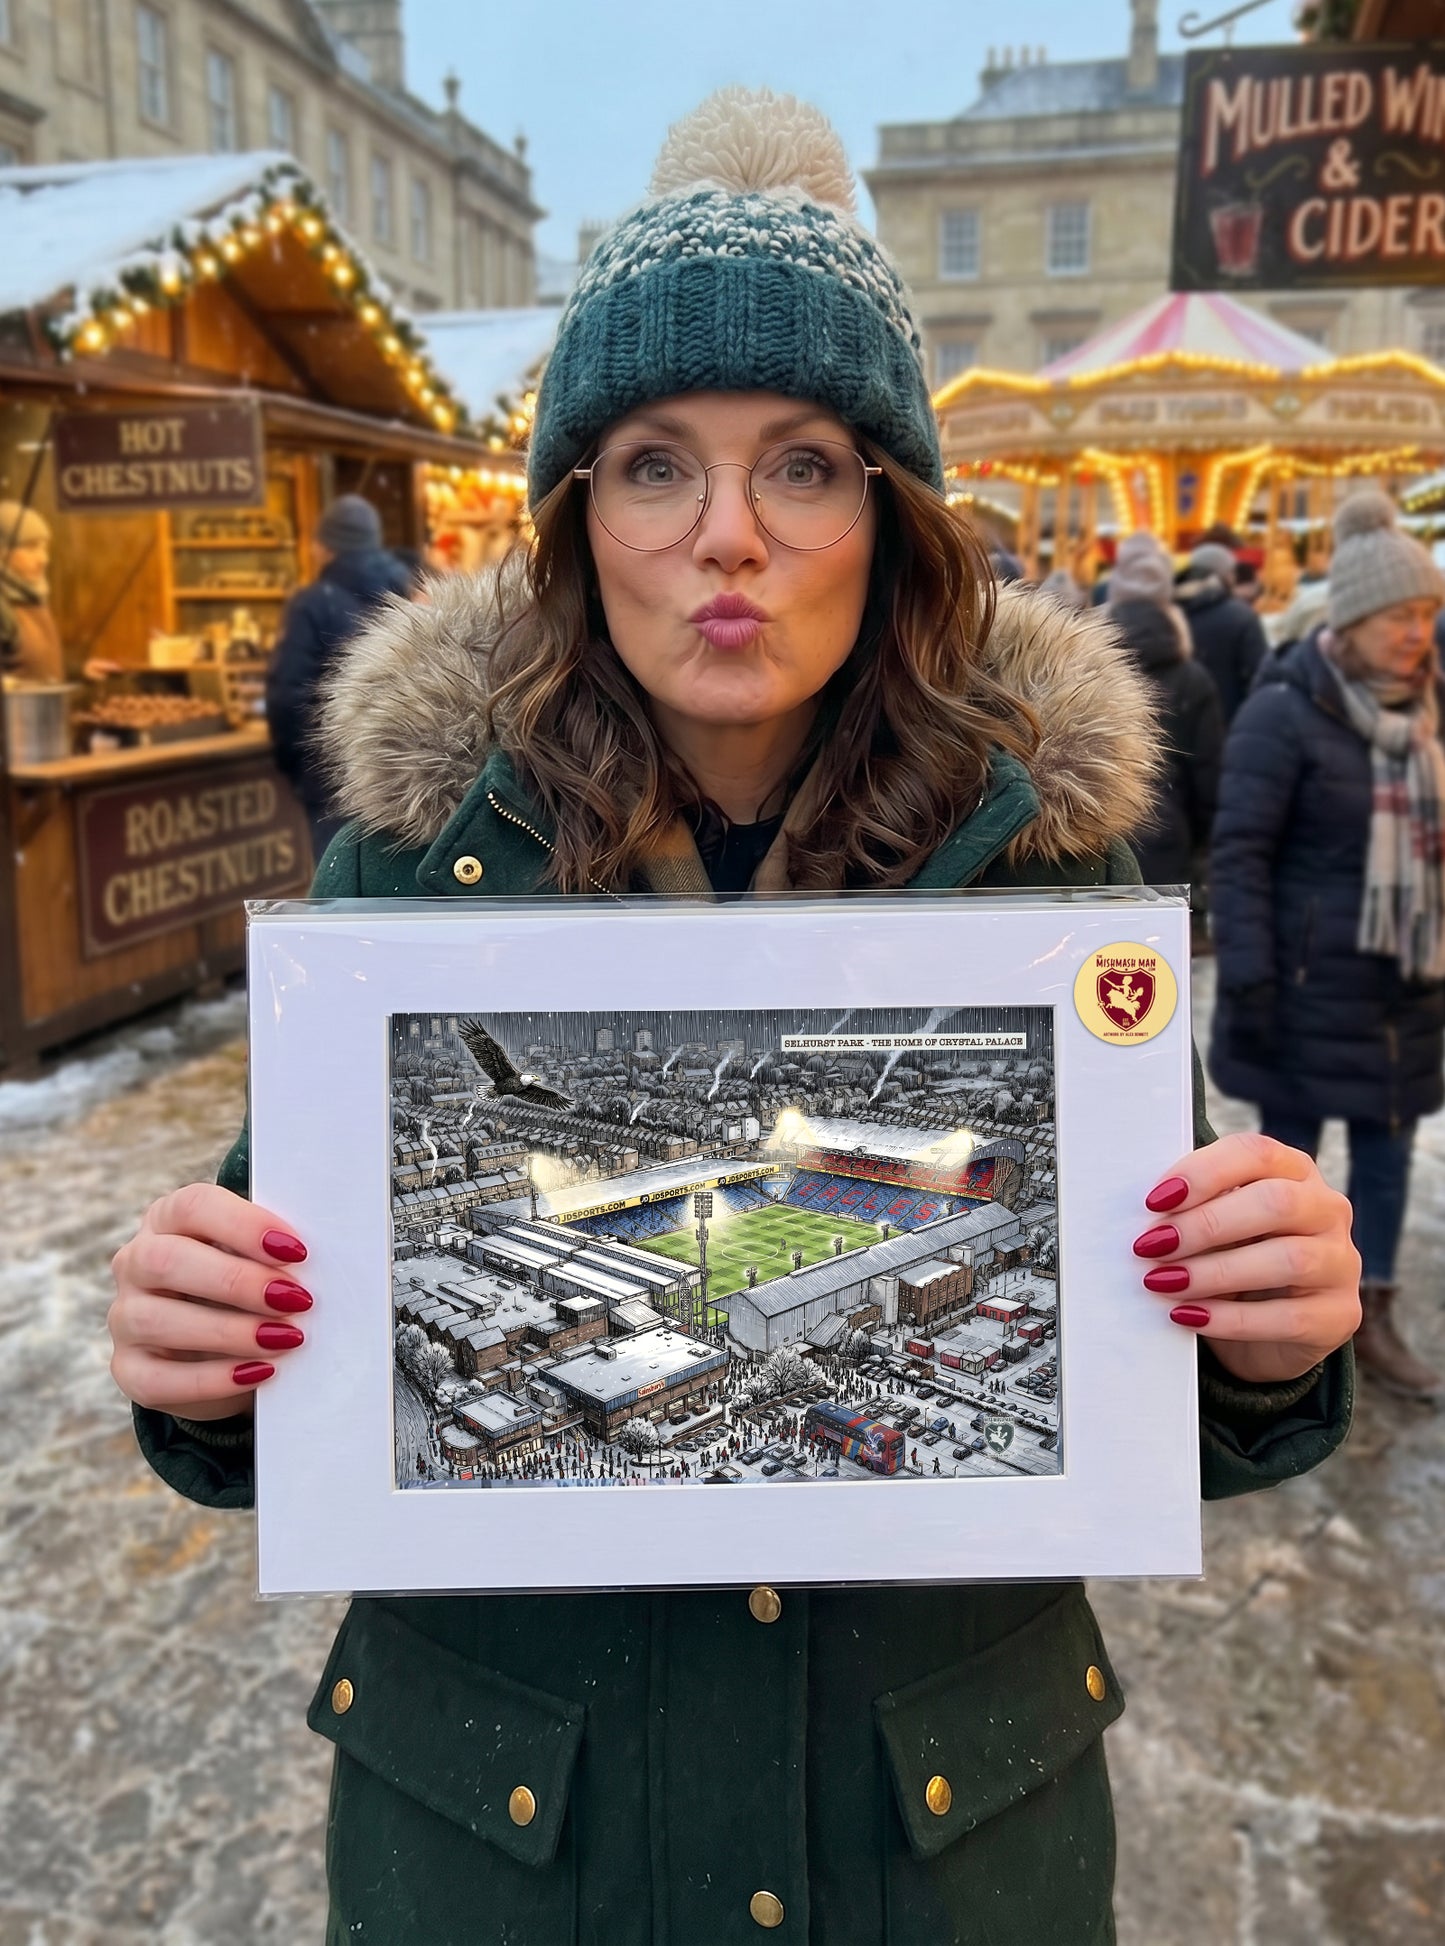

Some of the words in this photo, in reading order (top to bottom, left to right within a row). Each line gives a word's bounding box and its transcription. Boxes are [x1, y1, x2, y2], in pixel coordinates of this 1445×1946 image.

[1202, 70, 1373, 174] MULLED
[1320, 138, 1361, 190] &
[1288, 193, 1445, 260] CIDER
[119, 419, 187, 456] HOT
[62, 458, 255, 498] CHESTNUTS
[125, 779, 278, 858] ROASTED
[103, 829, 296, 927] CHESTNUTS
[1096, 958, 1135, 967] MISHMASH
[1138, 958, 1155, 967] MAN
[784, 1039, 835, 1048] SELHURST
[837, 1039, 865, 1047] PARK
[871, 1039, 892, 1047] THE
[893, 1038, 923, 1047] HOME
[924, 1038, 938, 1046] OF
[939, 1038, 983, 1046] CRYSTAL
[985, 1037, 1023, 1046] PALACE
[561, 1201, 626, 1222] JDSPORTS.COM
[651, 1182, 706, 1201] JDSPORTS.COM
[727, 1166, 775, 1183] JDSPORTS.COM
